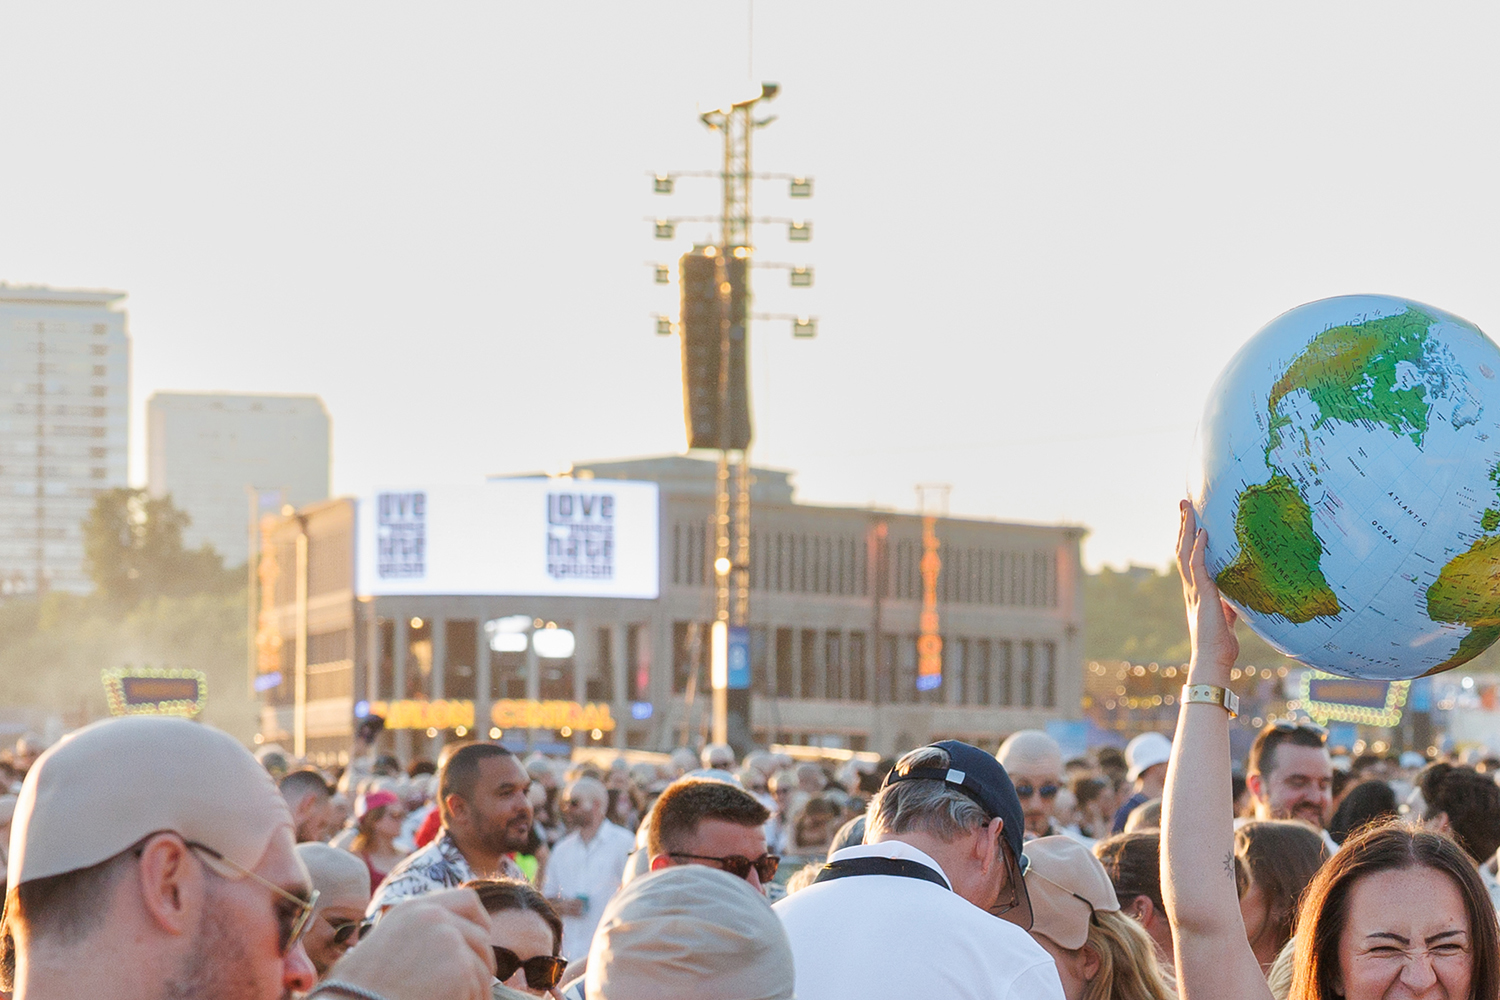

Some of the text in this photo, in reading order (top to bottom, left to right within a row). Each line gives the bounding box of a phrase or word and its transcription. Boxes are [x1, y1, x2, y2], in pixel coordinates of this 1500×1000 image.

[1387, 491, 1428, 527] ATLANTIC
[1371, 520, 1399, 545] OCEAN
[1244, 526, 1308, 602] SOUTH AMERICA
